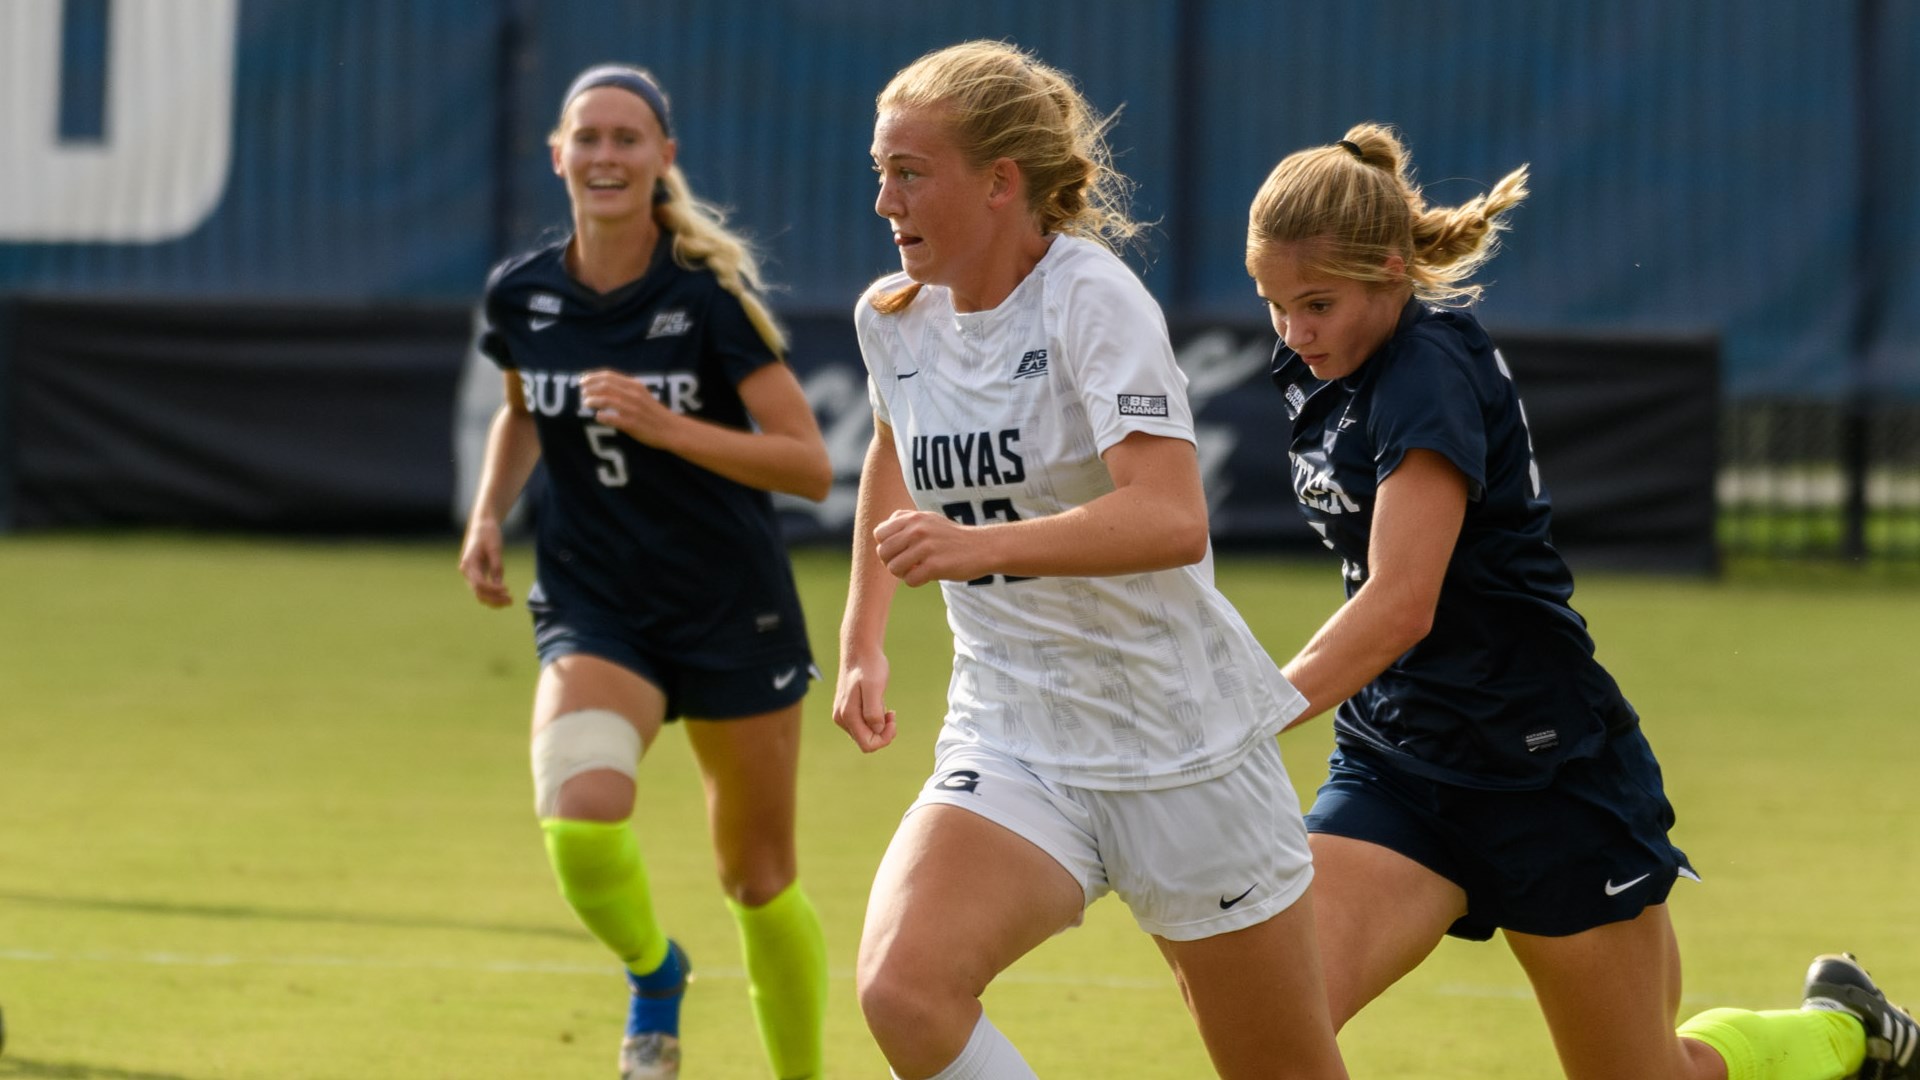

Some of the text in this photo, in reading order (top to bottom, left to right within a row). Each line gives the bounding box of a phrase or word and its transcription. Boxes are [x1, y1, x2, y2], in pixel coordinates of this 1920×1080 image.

[1016, 359, 1048, 374] EAS
[1021, 349, 1047, 363] BIG
[519, 371, 702, 418] BUTER
[1120, 405, 1167, 415] CHANGE
[584, 424, 629, 488] 5
[912, 428, 1026, 491] HOYAS
[934, 769, 980, 795] G
